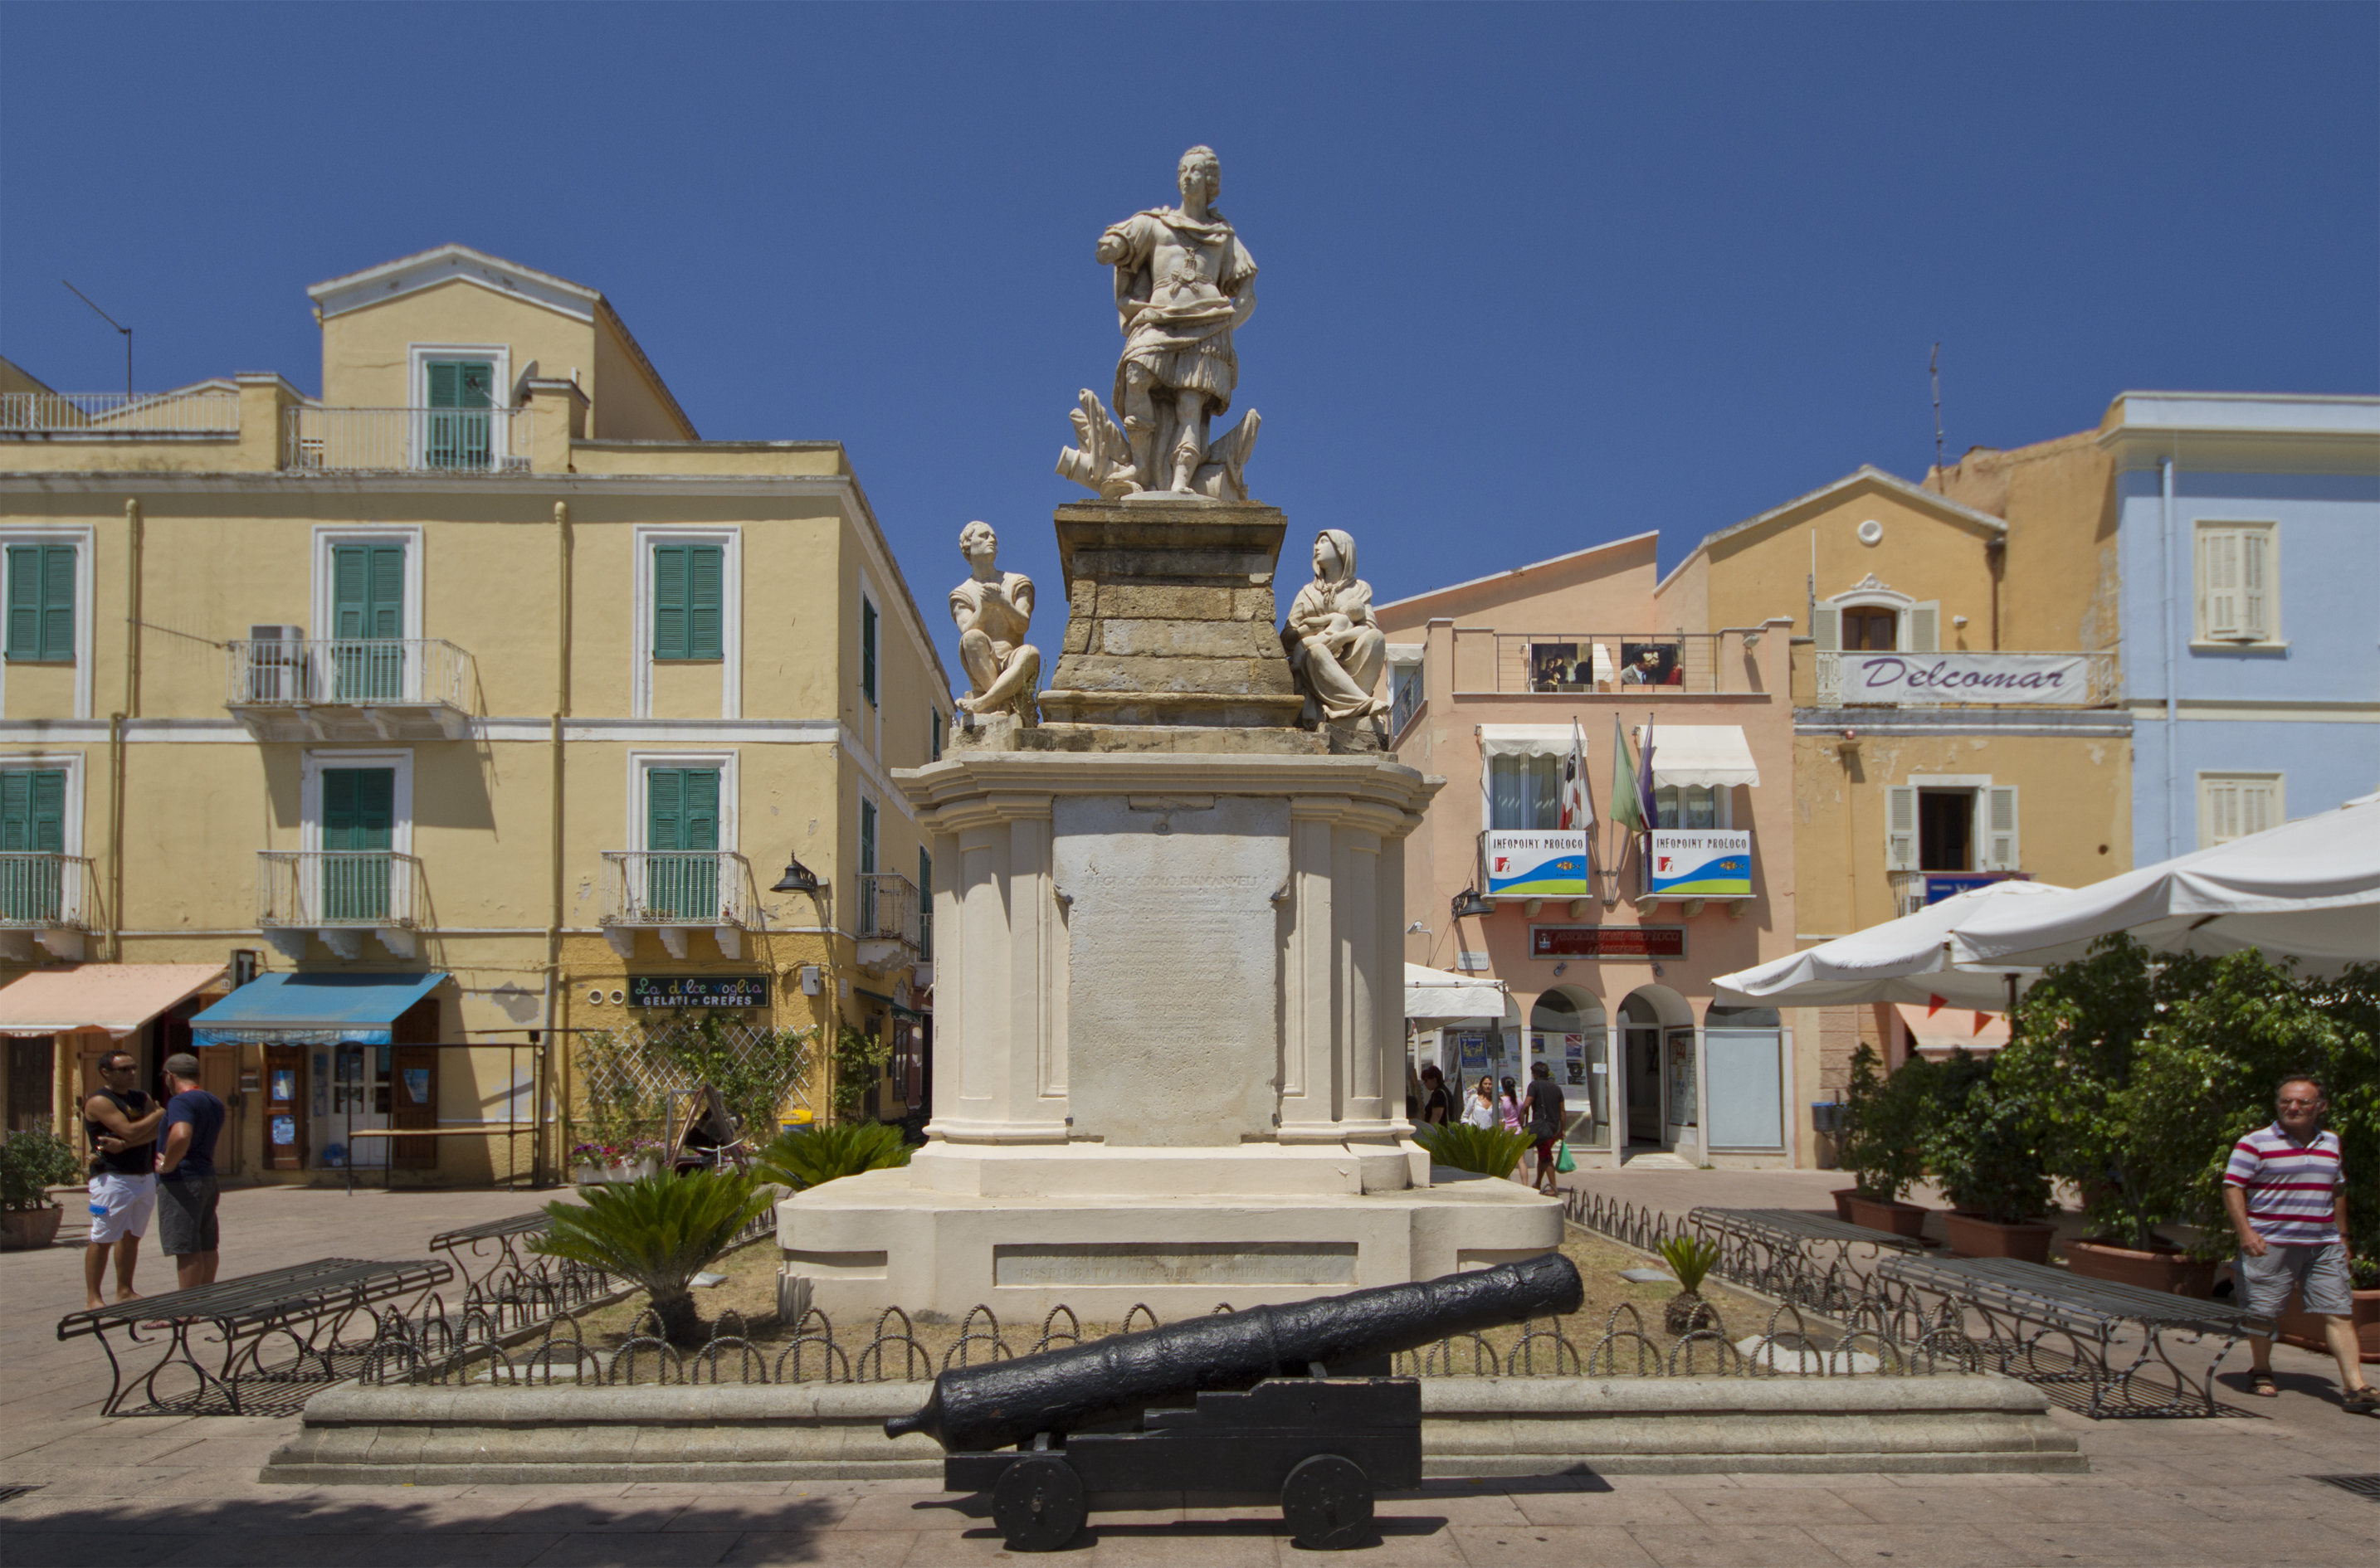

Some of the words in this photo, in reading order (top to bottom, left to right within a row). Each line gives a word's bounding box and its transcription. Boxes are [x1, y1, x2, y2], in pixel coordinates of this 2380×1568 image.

[1862, 657, 2065, 689] Delcomar
[1493, 838, 1539, 850] INFOPOINT
[1544, 838, 1583, 850] PROLOCO
[1656, 838, 1704, 849] INFOPOINT
[1708, 838, 1747, 849] PROLOCO
[1556, 932, 1626, 941] ASSOCIAZIONE
[1652, 933, 1679, 941] LOCO
[238, 953, 254, 985] T
[635, 977, 661, 995] La
[668, 979, 706, 995] dolce
[713, 979, 763, 996] voglia
[643, 996, 688, 1006] GELATI
[703, 996, 752, 1006] CREPES
[1021, 1268, 1110, 1279] RESTAURATO
[1116, 1268, 1124, 1279] A
[1128, 1267, 1163, 1278] CURA
[1167, 1267, 1193, 1278] DEL
[1201, 1267, 1266, 1278] MUNICIPIO
[1270, 1267, 1296, 1278] NEL
[1303, 1267, 1331, 1278] 1914
